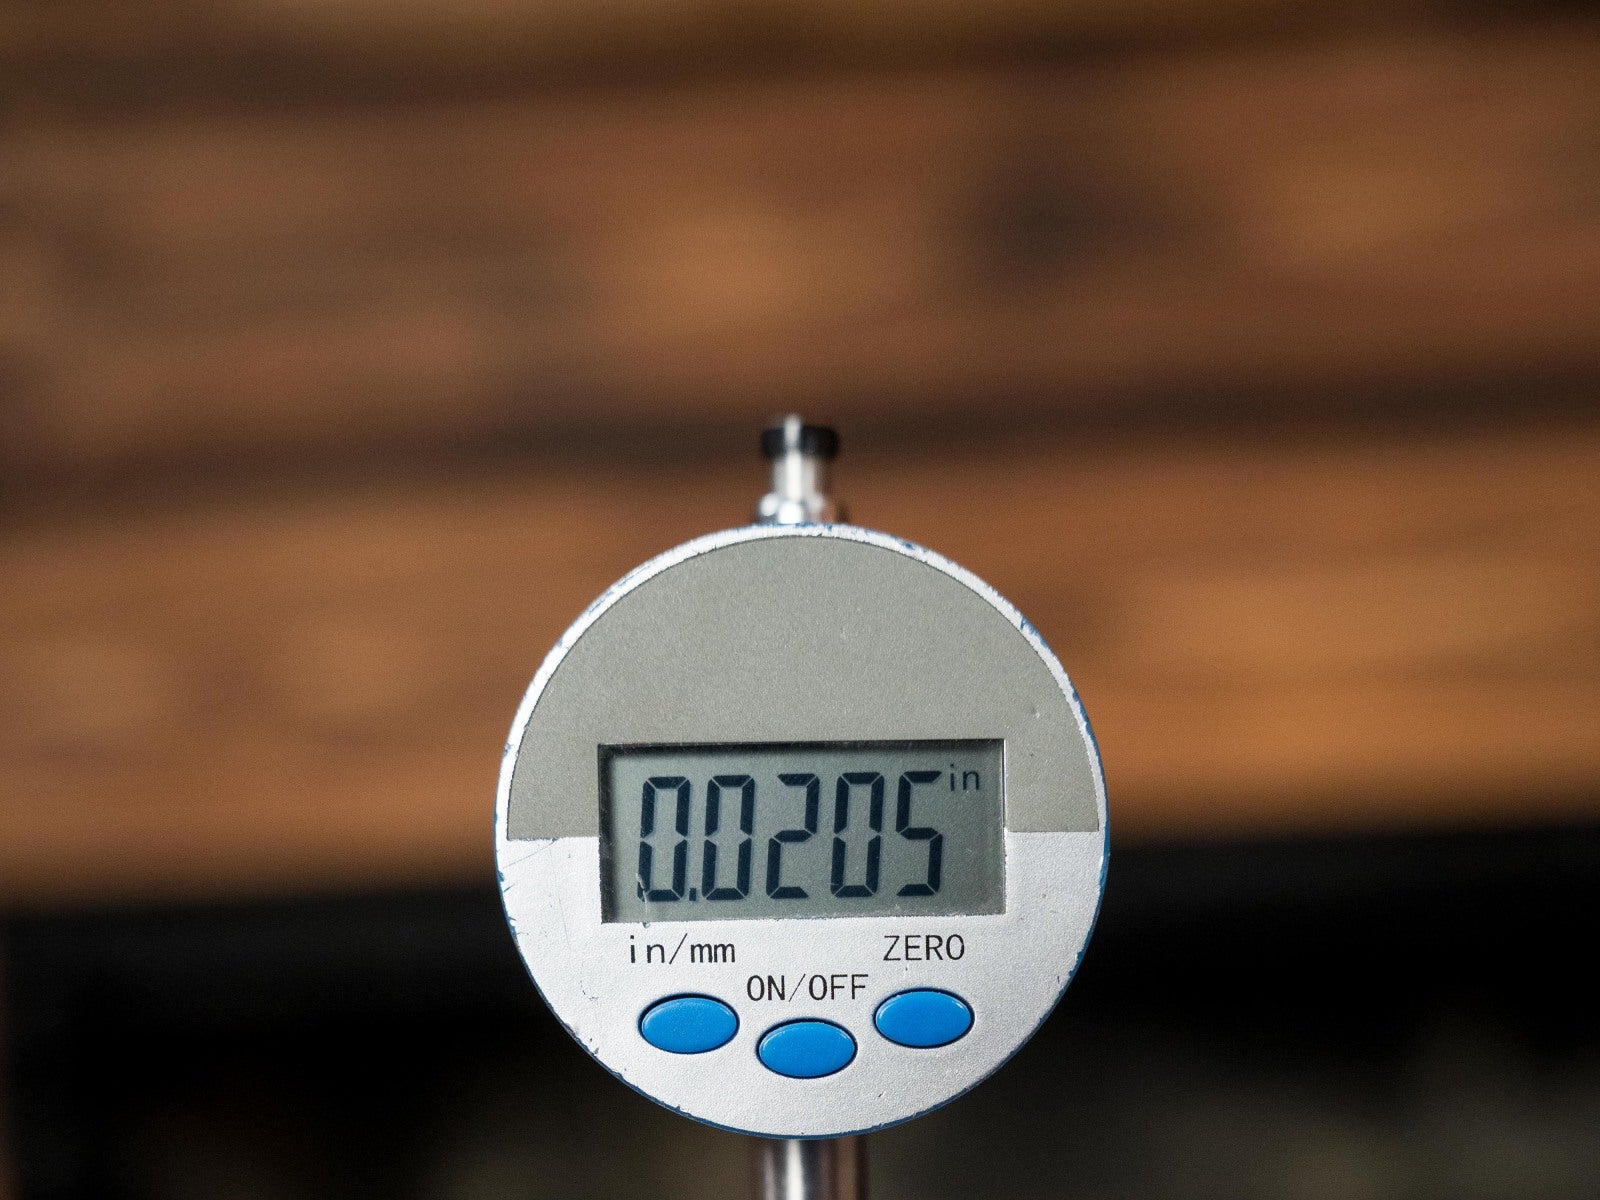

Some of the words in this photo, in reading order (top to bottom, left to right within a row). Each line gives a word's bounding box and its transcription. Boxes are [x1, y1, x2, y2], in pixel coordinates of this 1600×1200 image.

[637, 770, 943, 902] 0.0205
[949, 763, 981, 792] in
[629, 932, 736, 964] in/mm
[883, 933, 966, 961] ZERO
[746, 973, 869, 1002] ON/OFF
